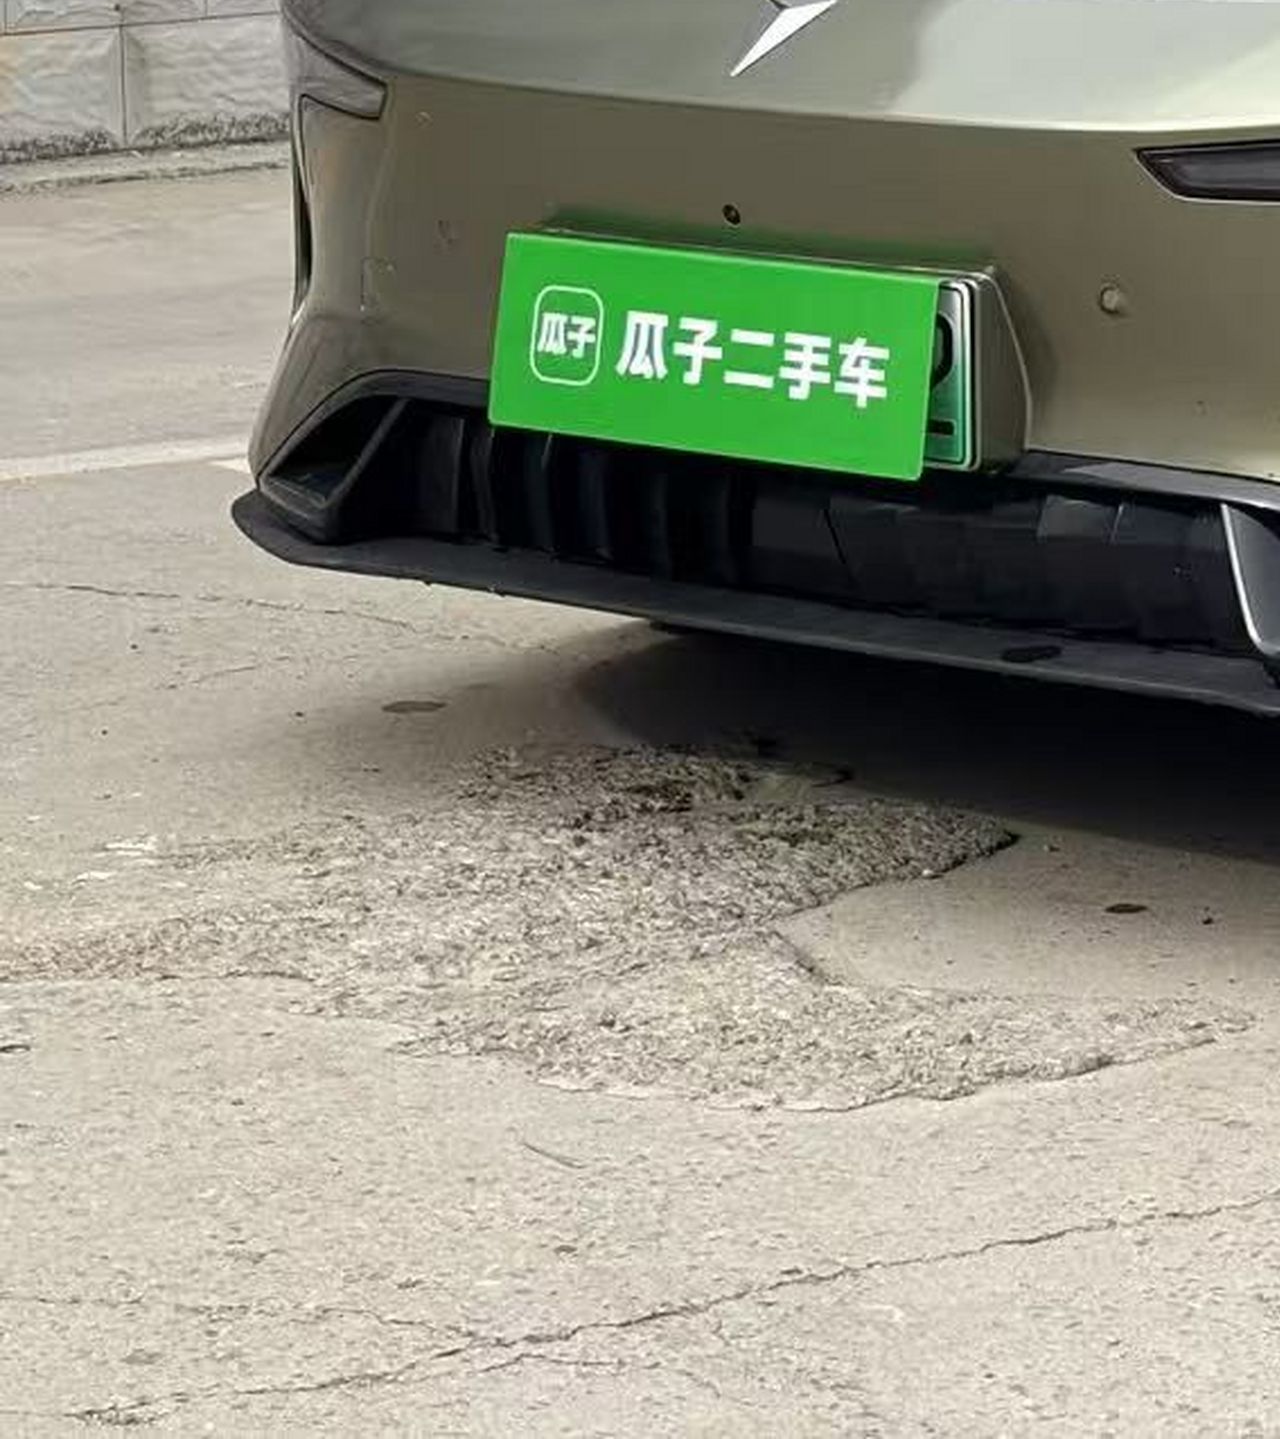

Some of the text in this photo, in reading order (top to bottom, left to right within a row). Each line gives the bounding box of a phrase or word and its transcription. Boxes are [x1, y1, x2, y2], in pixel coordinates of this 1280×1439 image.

[536, 311, 597, 358] 瓜子
[615, 310, 890, 409] 瓜子二手车
